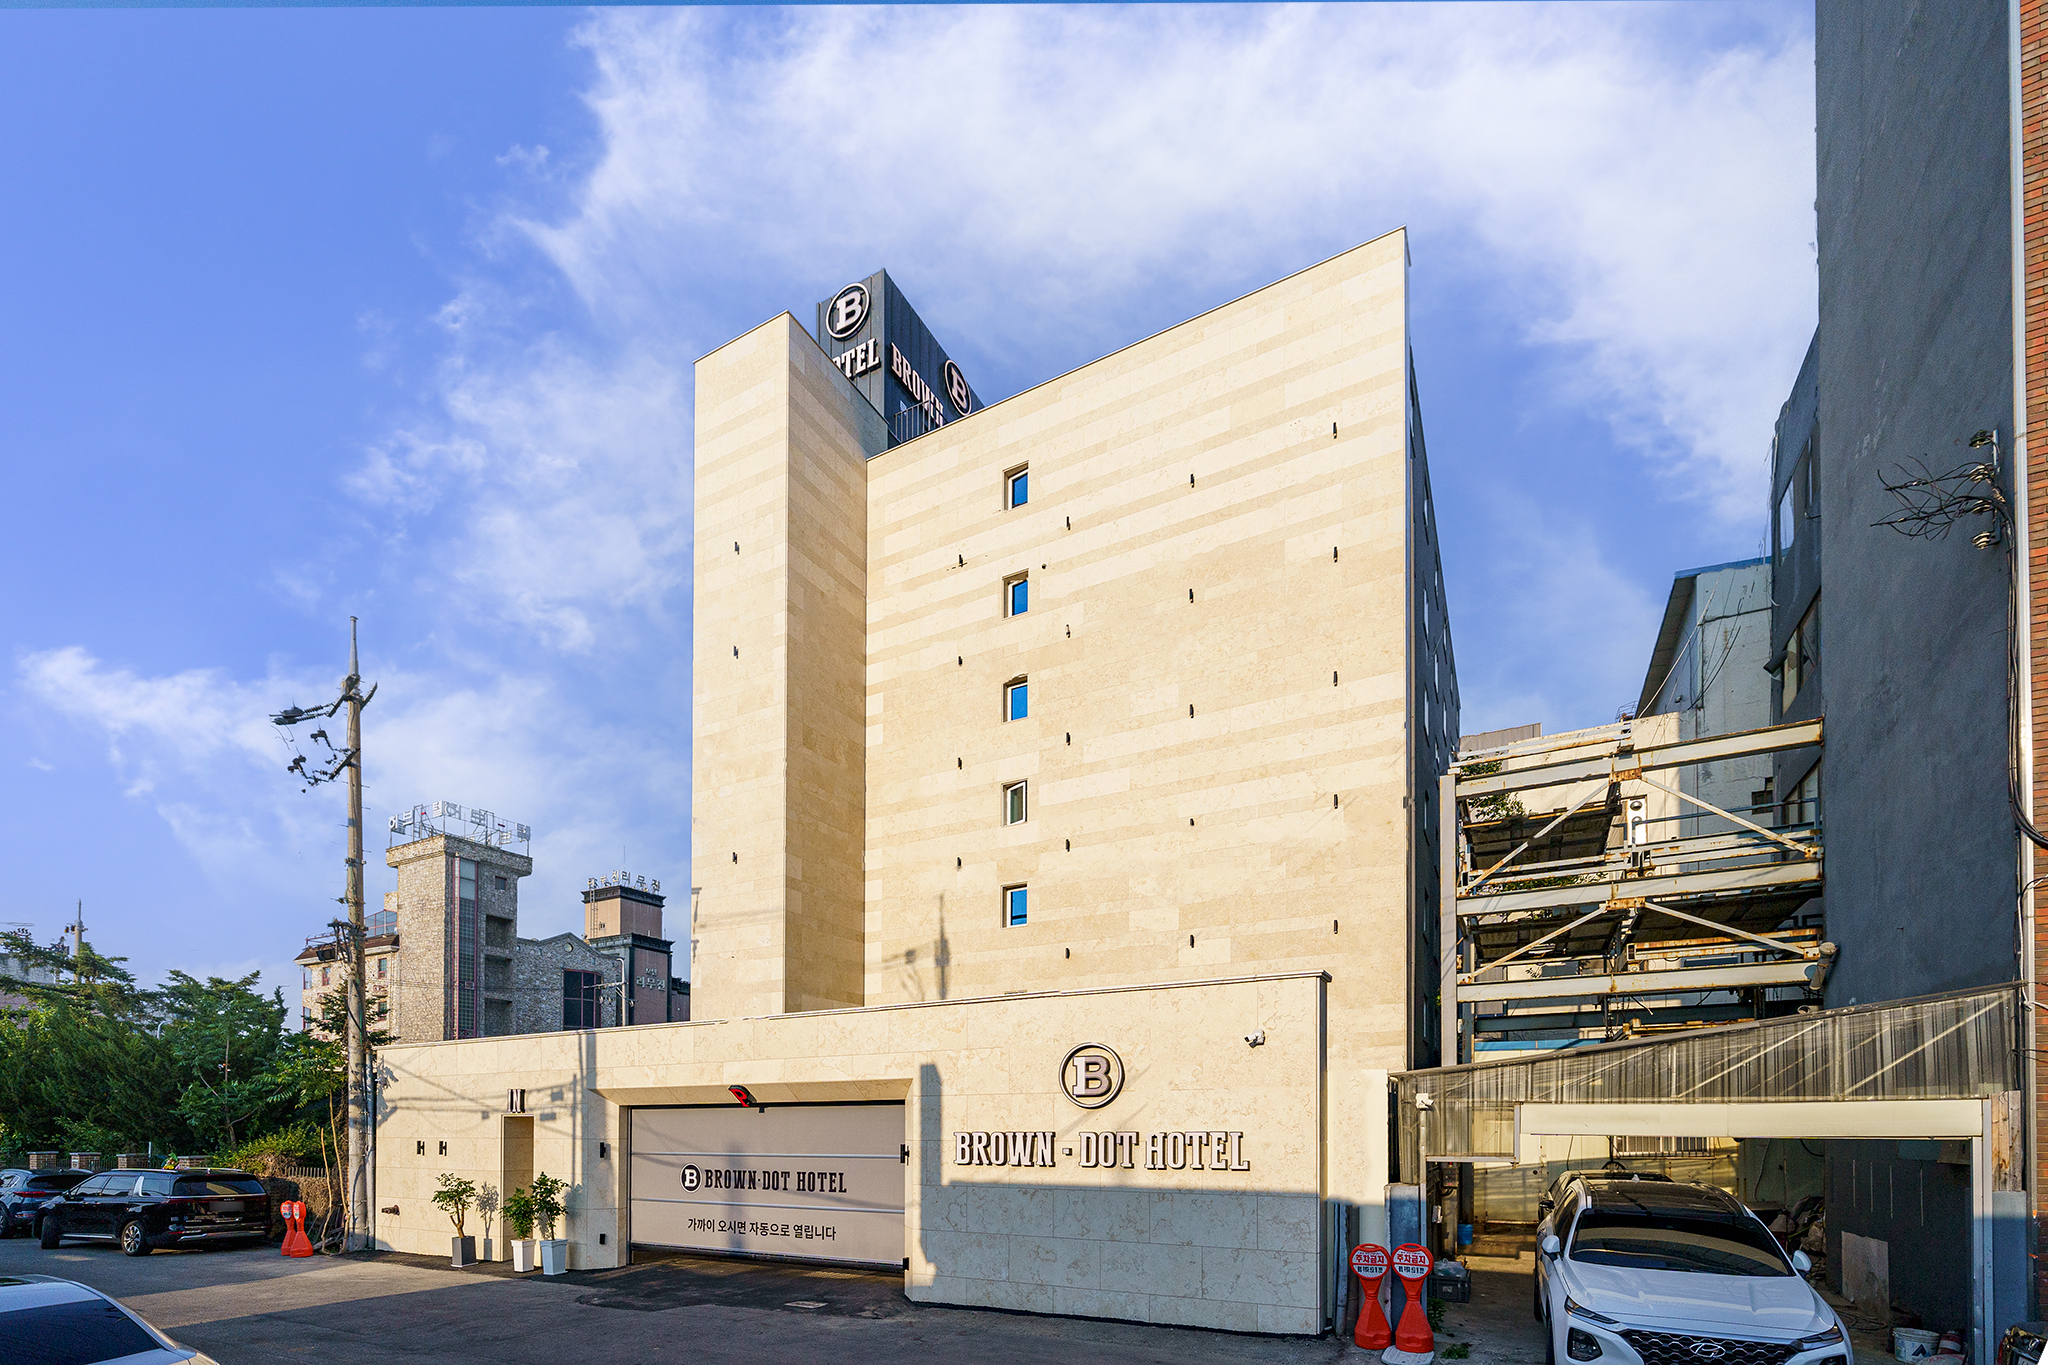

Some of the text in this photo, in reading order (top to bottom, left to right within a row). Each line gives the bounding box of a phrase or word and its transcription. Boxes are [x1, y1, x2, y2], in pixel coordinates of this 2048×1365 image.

[836, 290, 863, 332] B
[1072, 1055, 1112, 1097] B
[953, 1131, 1250, 1171] BROWN DOT HOTEL
[796, 1171, 847, 1193] HOTEL
[688, 1218, 836, 1241] 가까이 오시면 자동으로 열립니다
[1356, 1254, 1385, 1263] 주차금지
[1397, 1253, 1426, 1264] 주차금지
